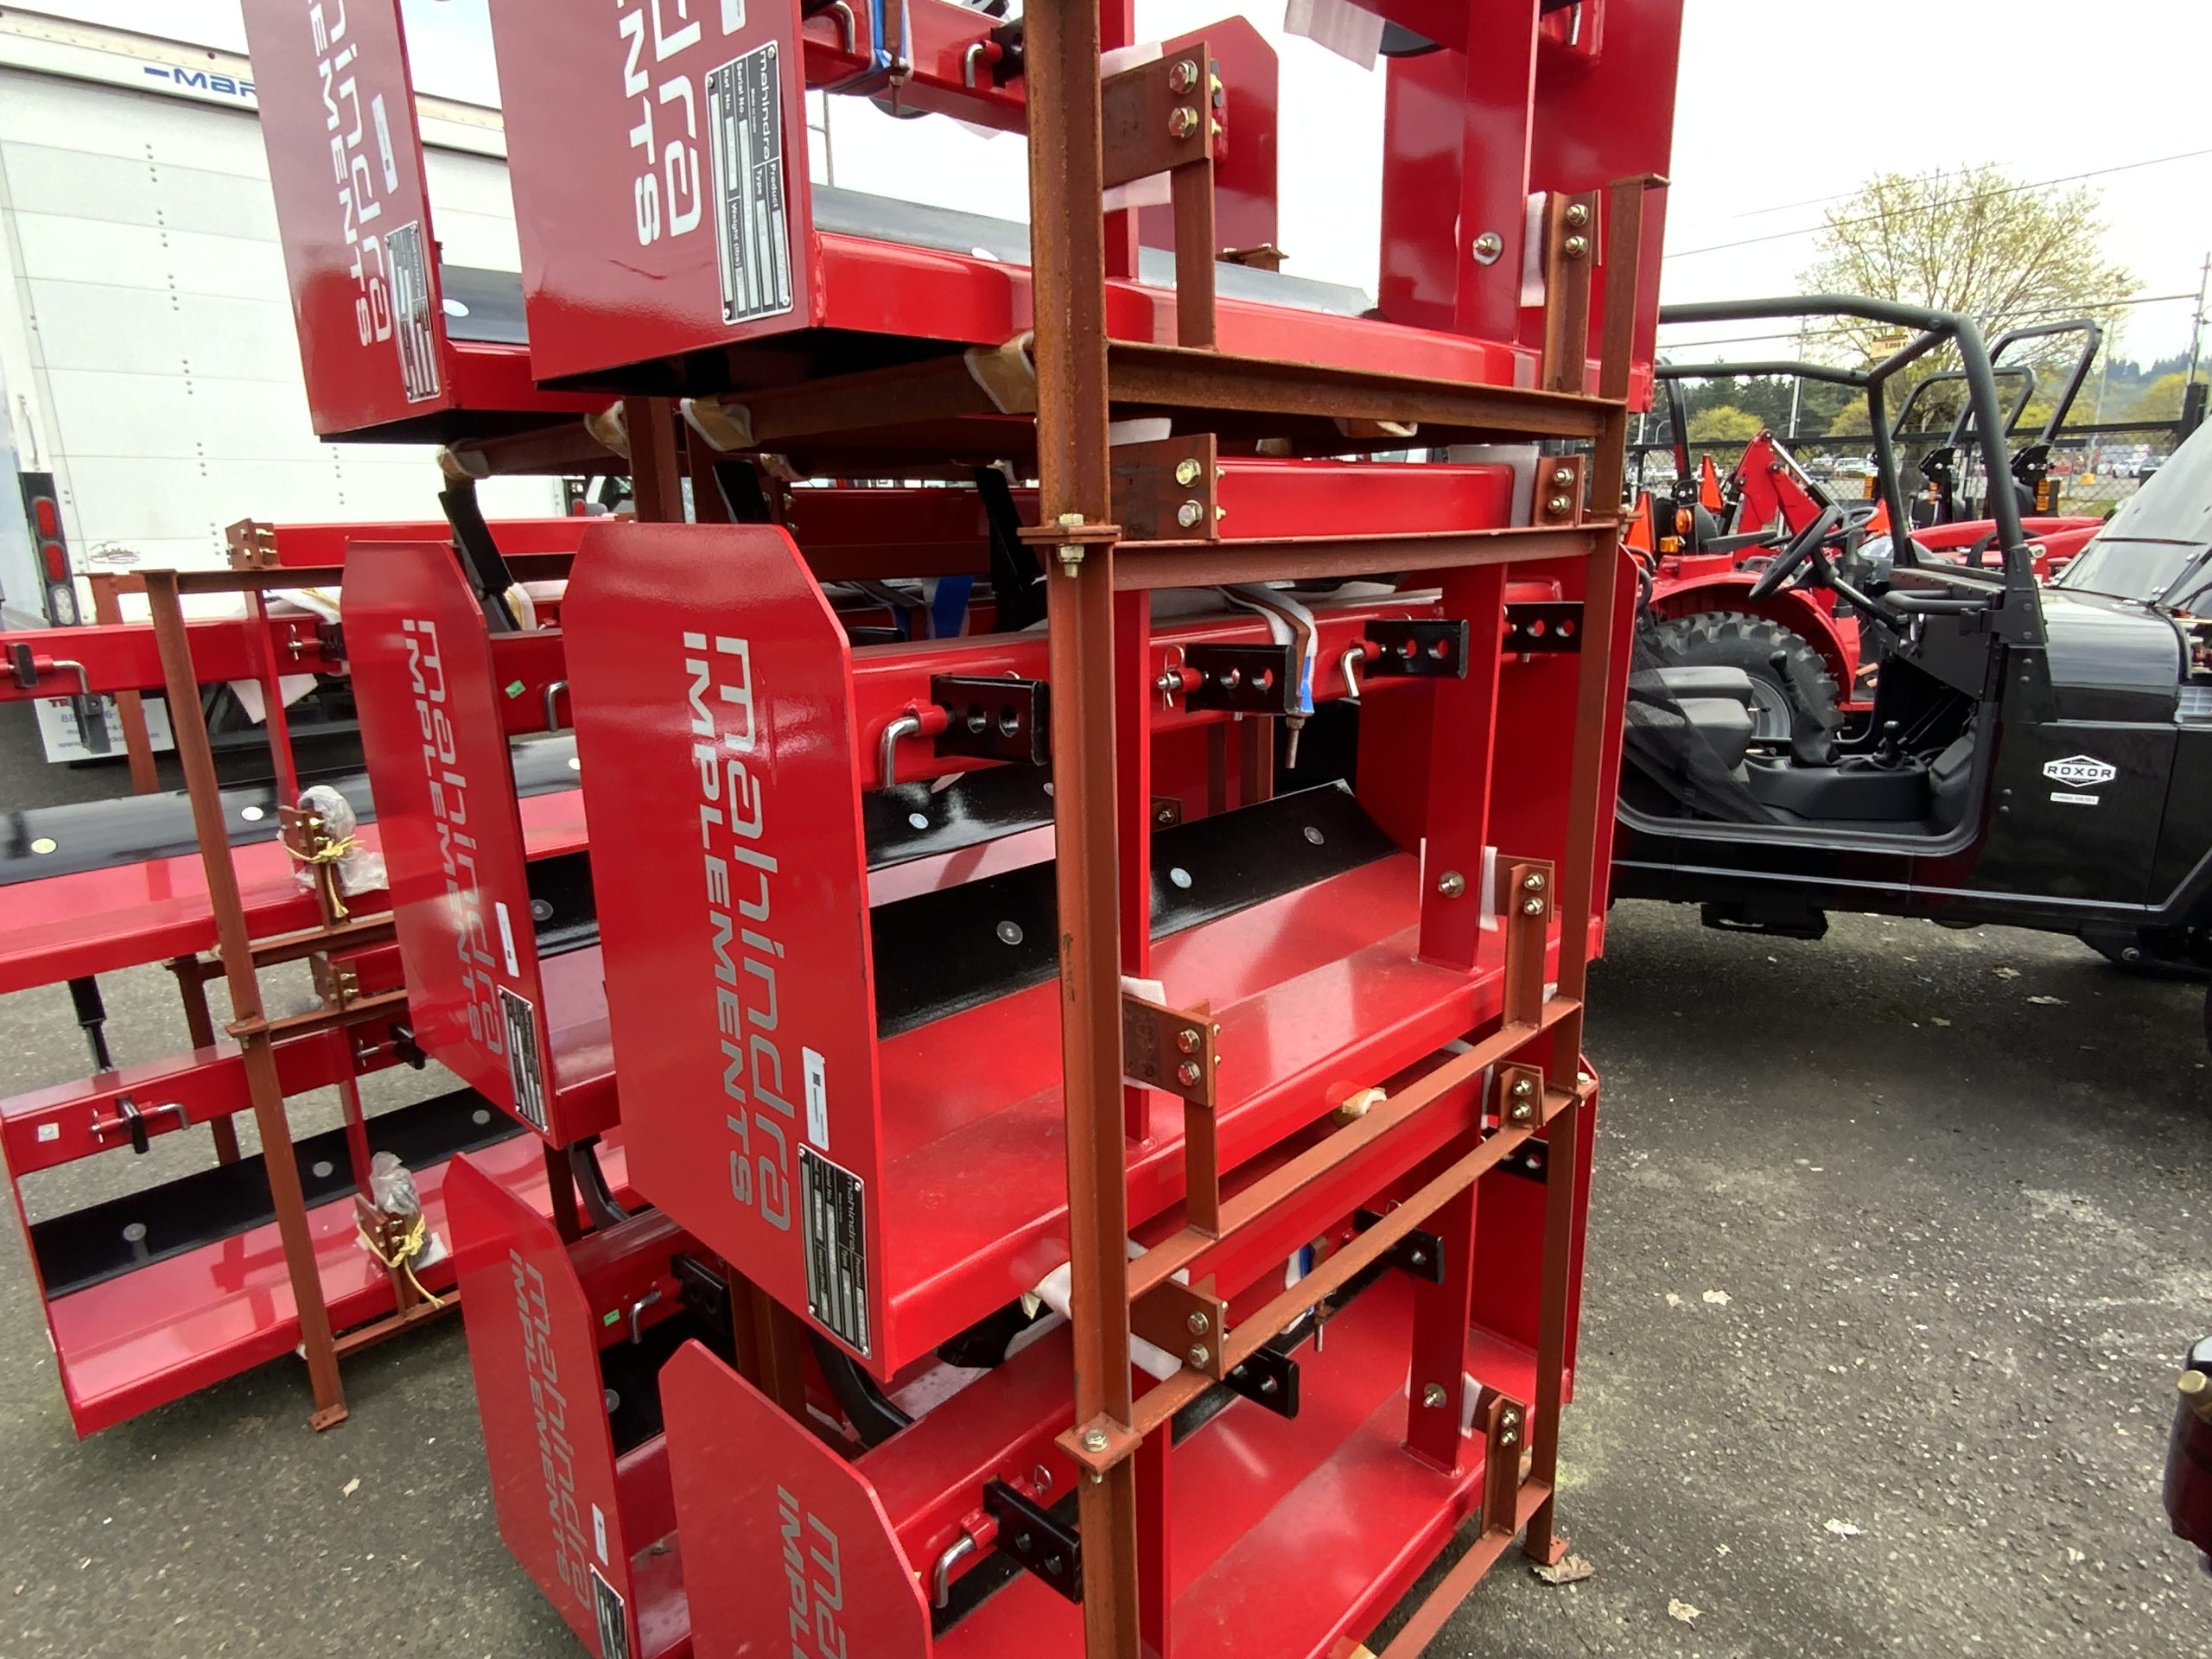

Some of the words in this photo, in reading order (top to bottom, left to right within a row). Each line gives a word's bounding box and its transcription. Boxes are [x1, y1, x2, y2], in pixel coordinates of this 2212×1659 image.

[308, 0, 372, 346] EMENTS
[617, 0, 661, 246] NTS
[731, 202, 740, 240] Weight
[736, 62, 745, 95] Serial
[760, 50, 771, 161] mahindra
[770, 163, 779, 208] Product
[402, 619, 483, 1041] IMPLEMENTS
[417, 620, 503, 1055] mahindra
[683, 631, 753, 1205] IMPLEMENTS
[715, 635, 795, 1231] mahindra
[2047, 766, 2112, 778] ROXOR
[509, 1248, 571, 1586] IMPLEMENTS
[525, 1262, 591, 1611] mahindra
